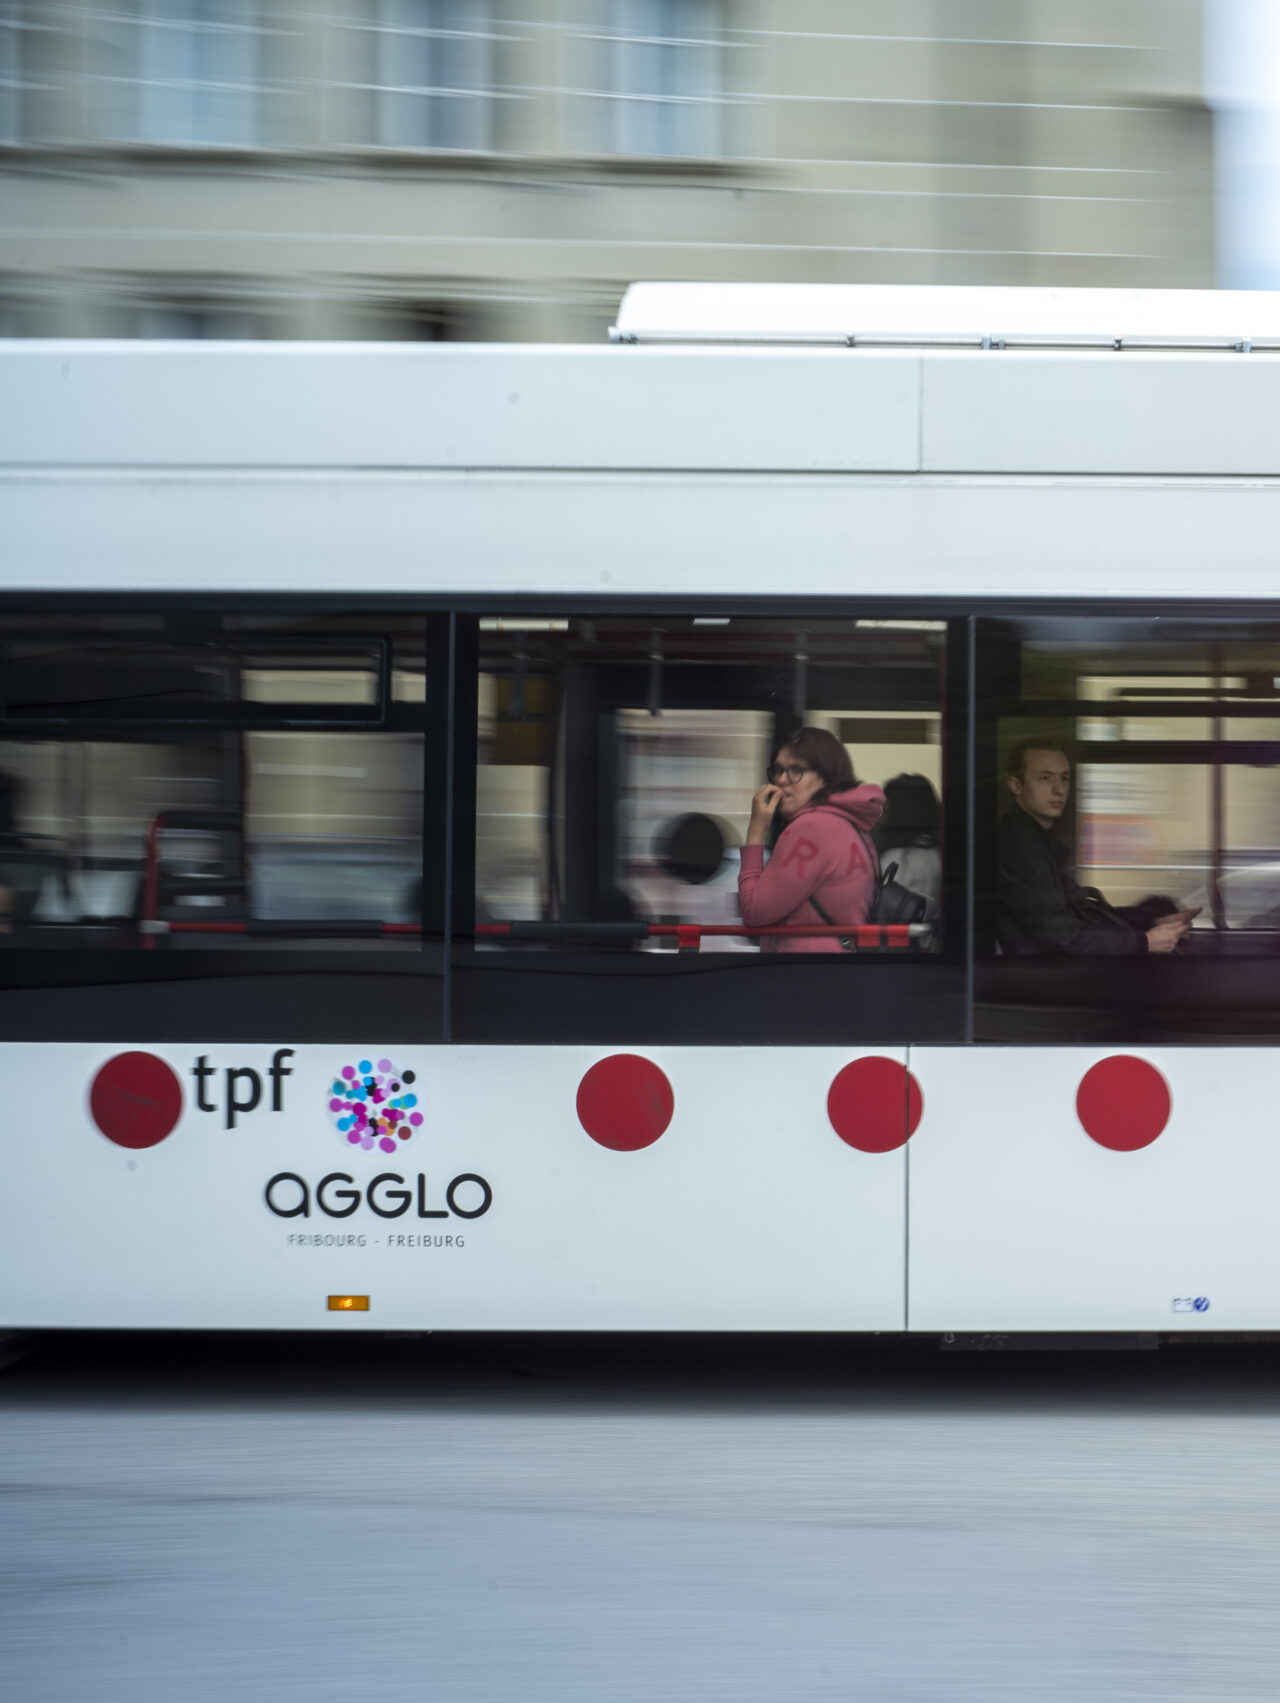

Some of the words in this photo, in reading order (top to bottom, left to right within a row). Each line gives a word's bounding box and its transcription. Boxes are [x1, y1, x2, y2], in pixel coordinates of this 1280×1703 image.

[191, 1048, 296, 1129] tpf
[287, 1233, 368, 1247] FRIBOURG
[387, 1233, 466, 1248] FREIBURG
